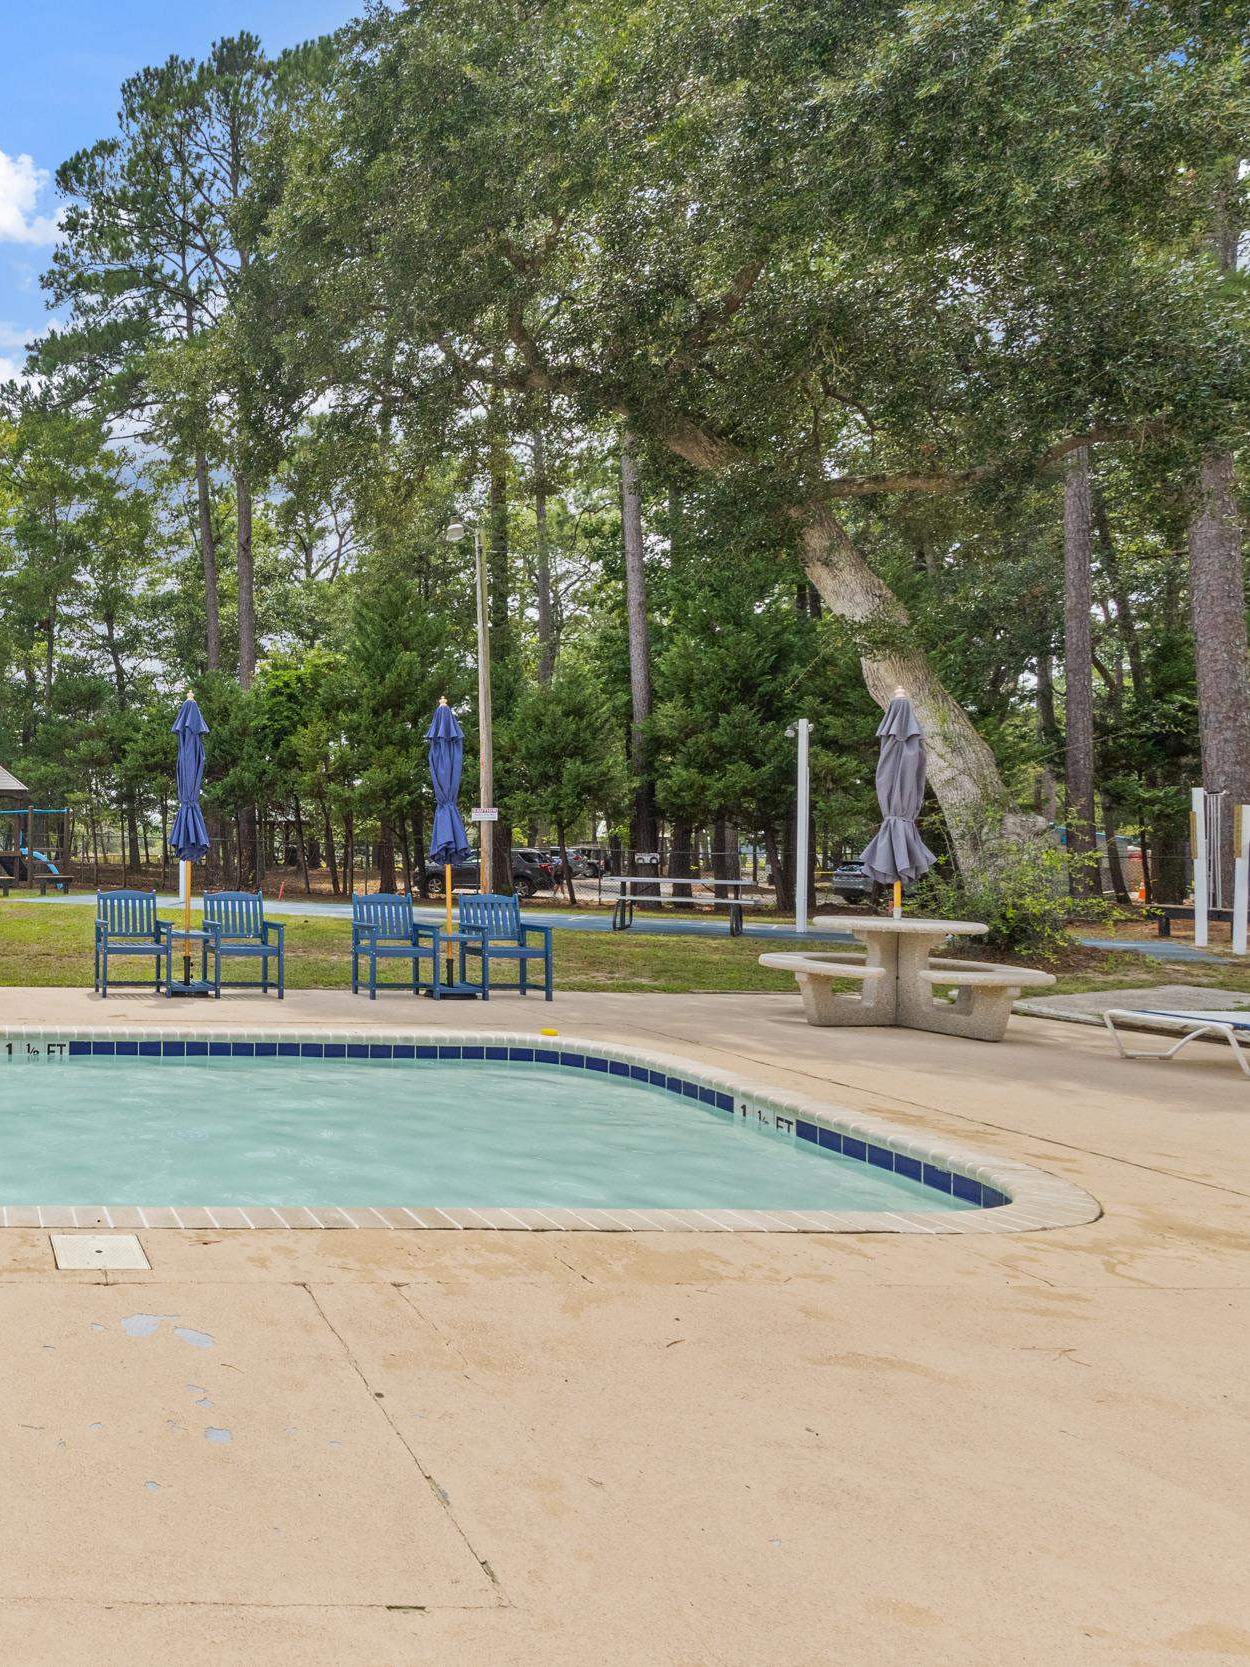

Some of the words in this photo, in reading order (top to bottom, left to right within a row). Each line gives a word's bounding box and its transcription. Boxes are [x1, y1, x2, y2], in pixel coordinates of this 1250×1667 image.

[5, 1043, 12, 1055] 1
[47, 1044, 66, 1055] FT
[740, 1104, 746, 1117] 1
[776, 1116, 793, 1133] FT
